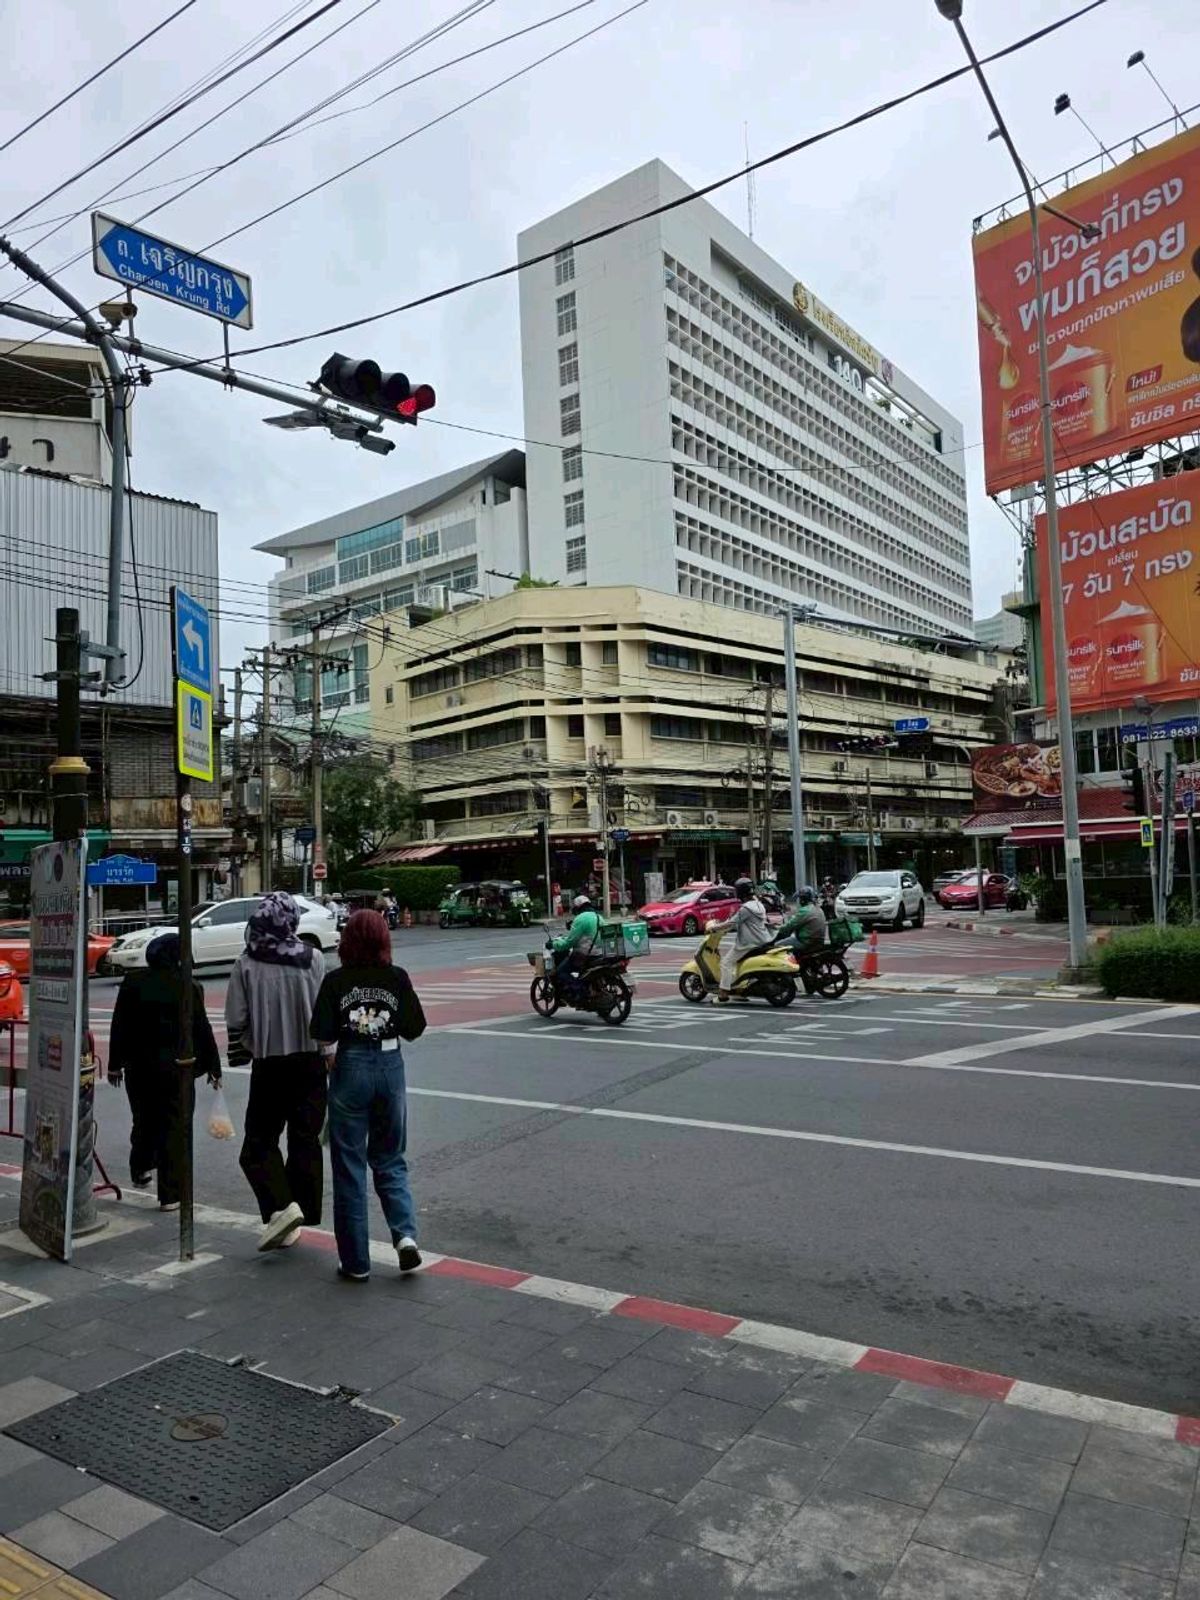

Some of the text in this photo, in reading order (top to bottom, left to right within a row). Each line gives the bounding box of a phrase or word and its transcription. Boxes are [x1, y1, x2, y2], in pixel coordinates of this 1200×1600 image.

[117, 239, 233, 304] ถ. เจริญกรุง
[118, 263, 231, 316] Charoen Krung Rd
[1018, 221, 1185, 332] ผมก็สวย
[1004, 397, 1040, 420] sunsilk
[1050, 386, 1091, 410] sunsilk
[1061, 498, 1192, 564] ม้วนสะบัด
[1062, 550, 1194, 605] 7 วัน 7 ทรง
[1106, 639, 1145, 656] sunsilk
